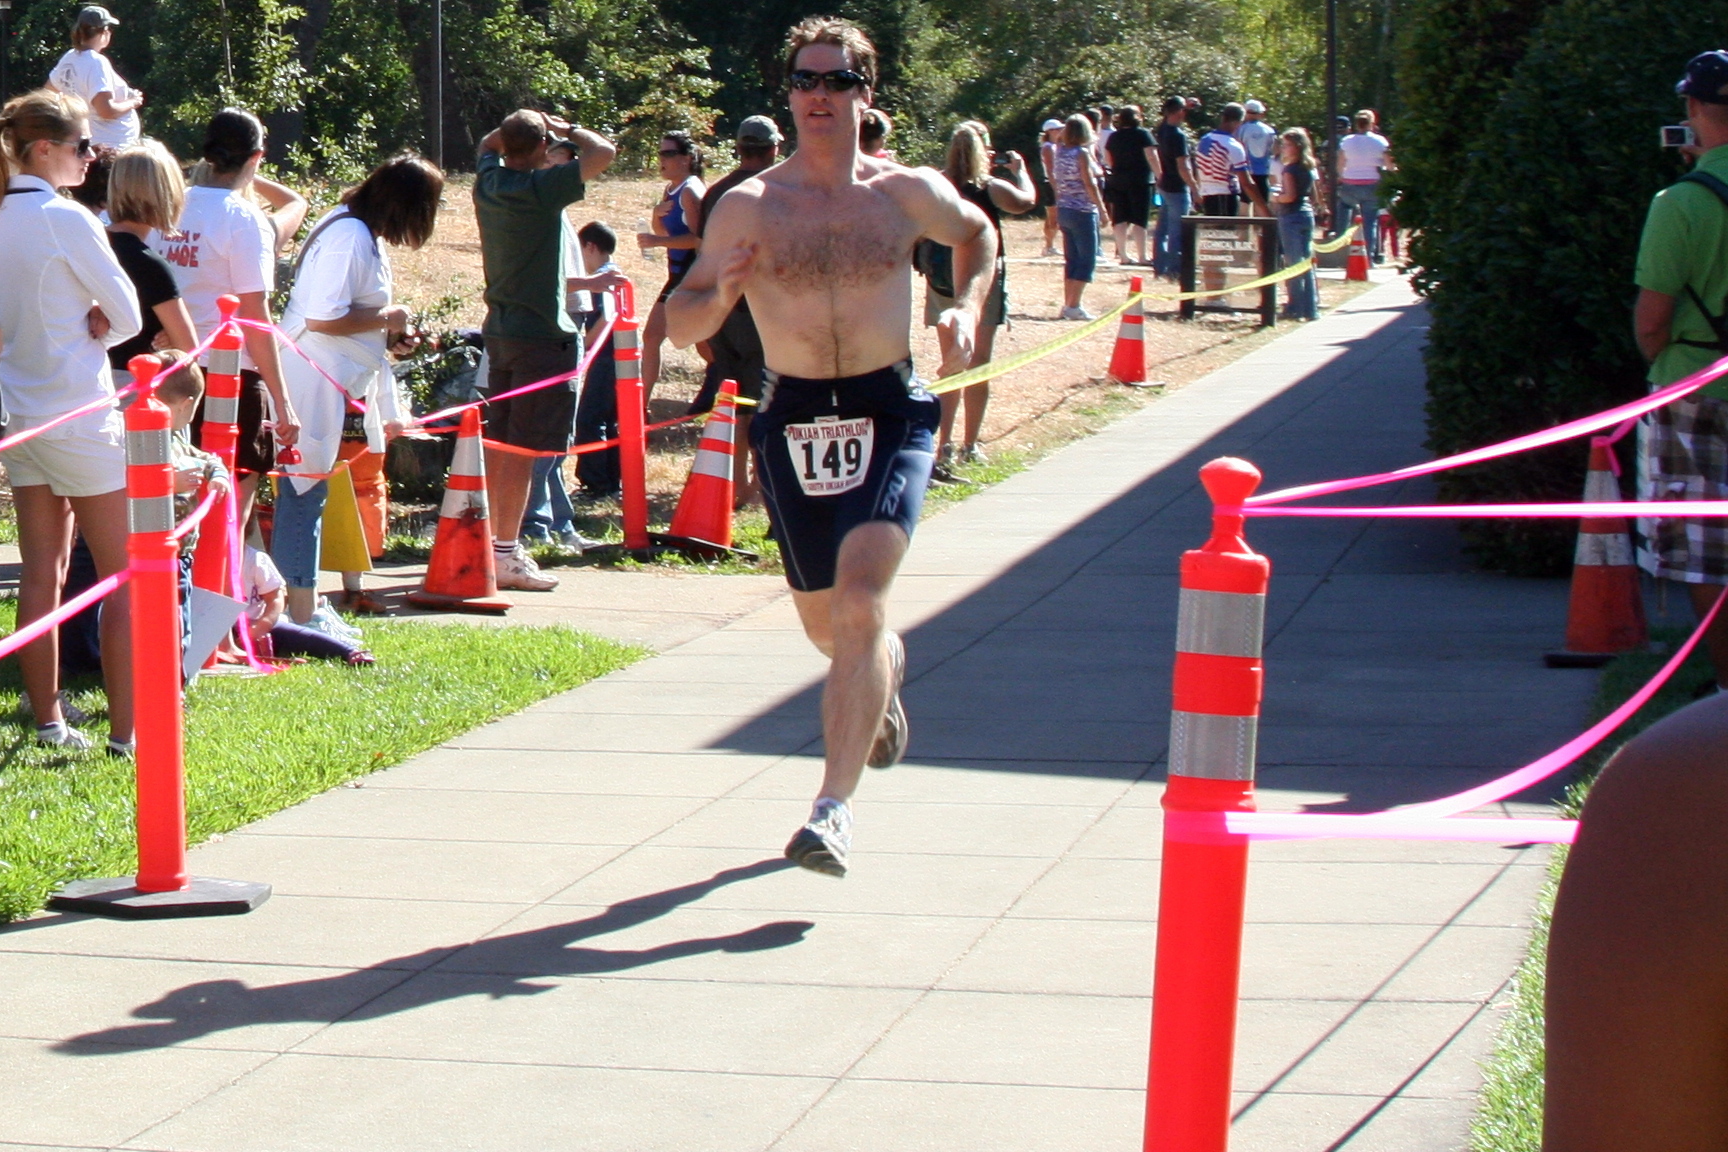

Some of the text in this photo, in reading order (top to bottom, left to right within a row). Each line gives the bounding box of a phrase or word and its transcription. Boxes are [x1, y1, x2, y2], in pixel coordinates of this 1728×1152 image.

[793, 423, 869, 441] UKIAH TRIATHLON
[802, 438, 863, 480] 149
